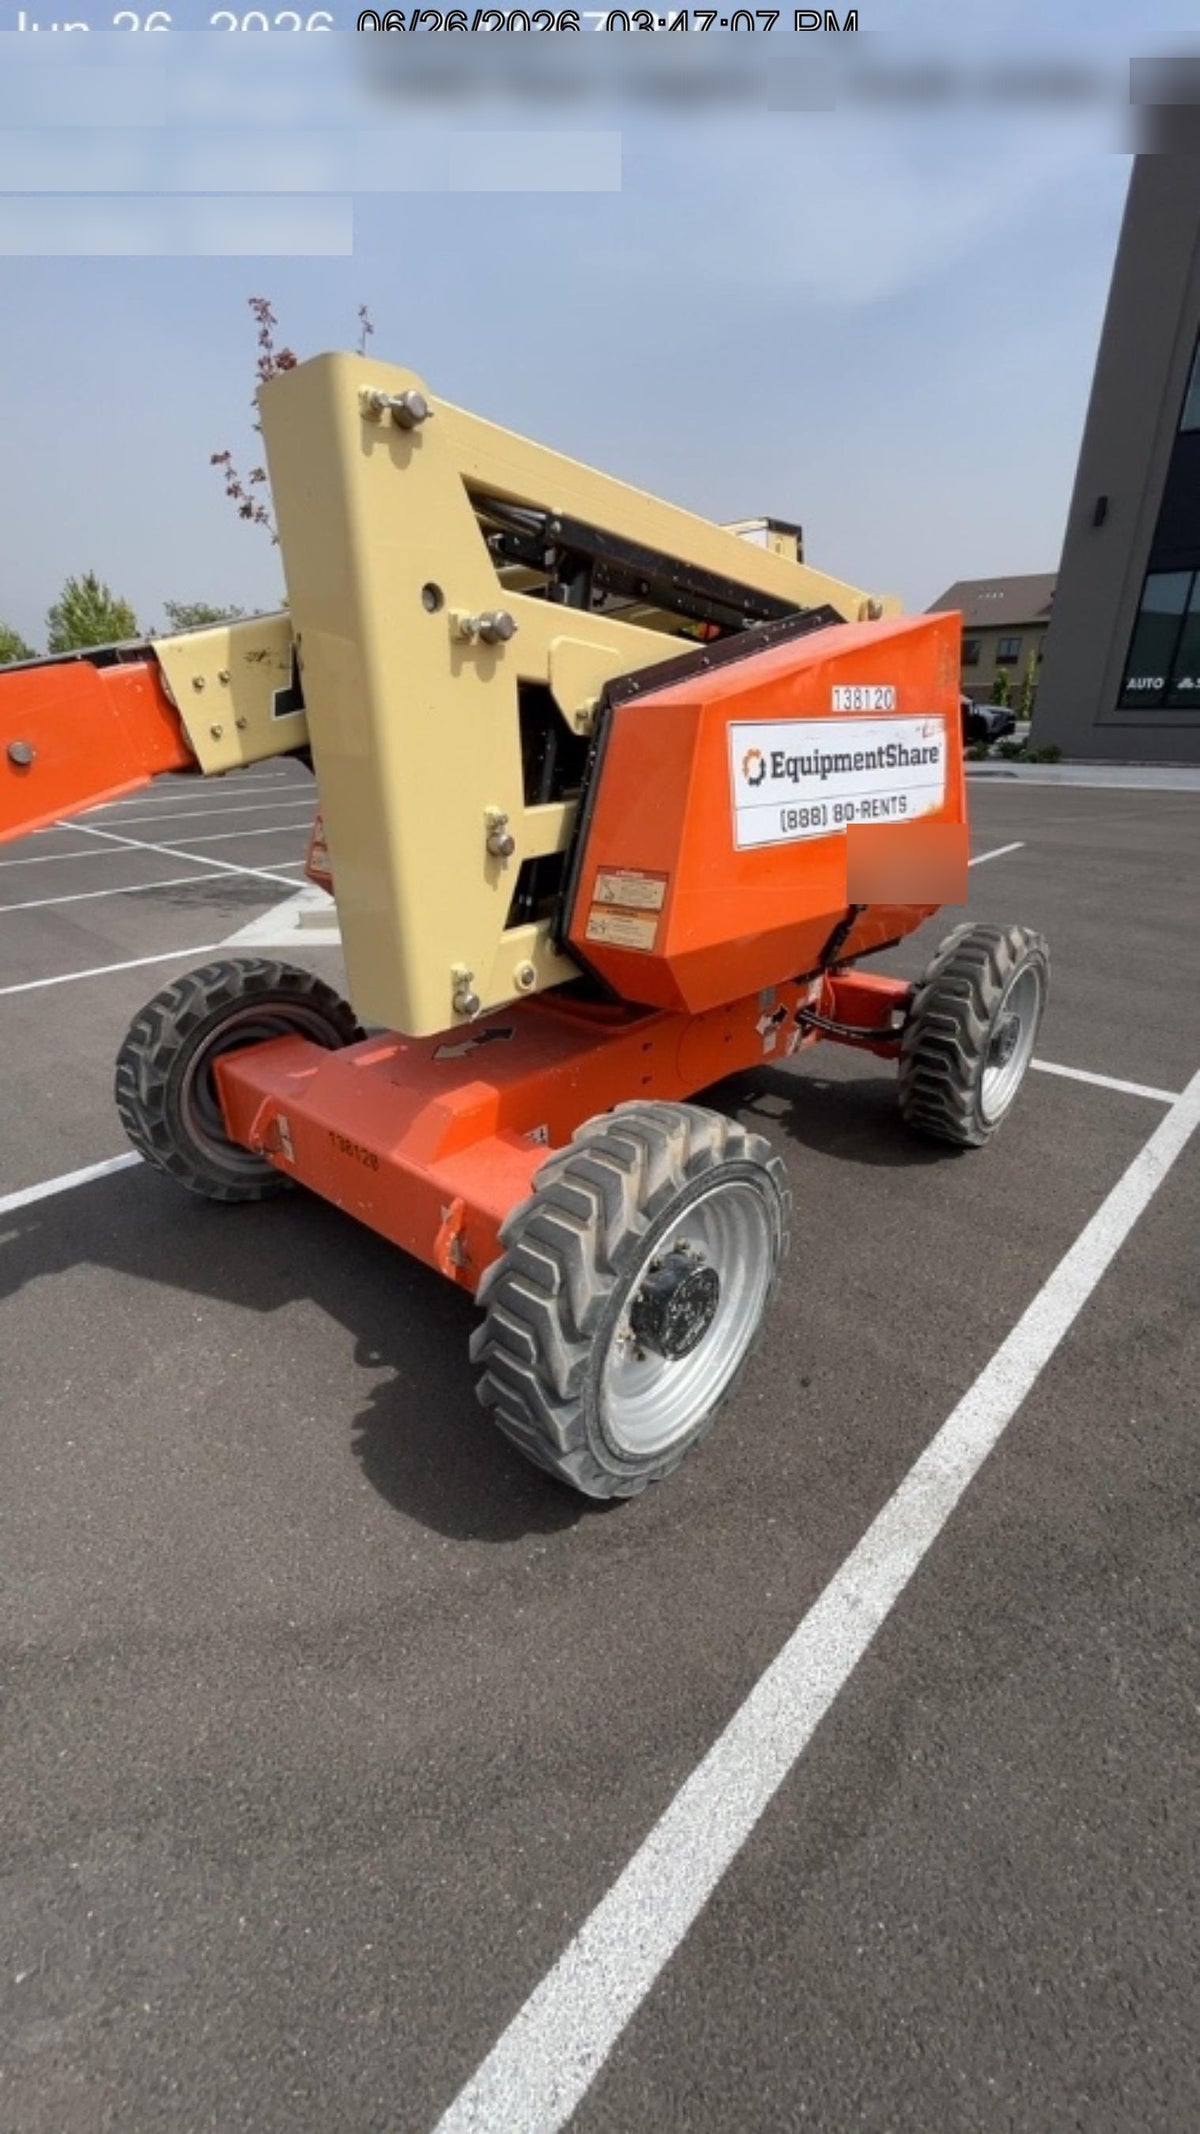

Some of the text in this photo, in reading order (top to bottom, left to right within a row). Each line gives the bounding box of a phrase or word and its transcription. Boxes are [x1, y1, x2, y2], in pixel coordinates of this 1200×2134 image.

[834, 687, 893, 710] 138120
[1127, 678, 1164, 689] AUTO
[770, 743, 939, 783] EquipmentShare
[780, 795, 908, 832] (888) 80-RENTS
